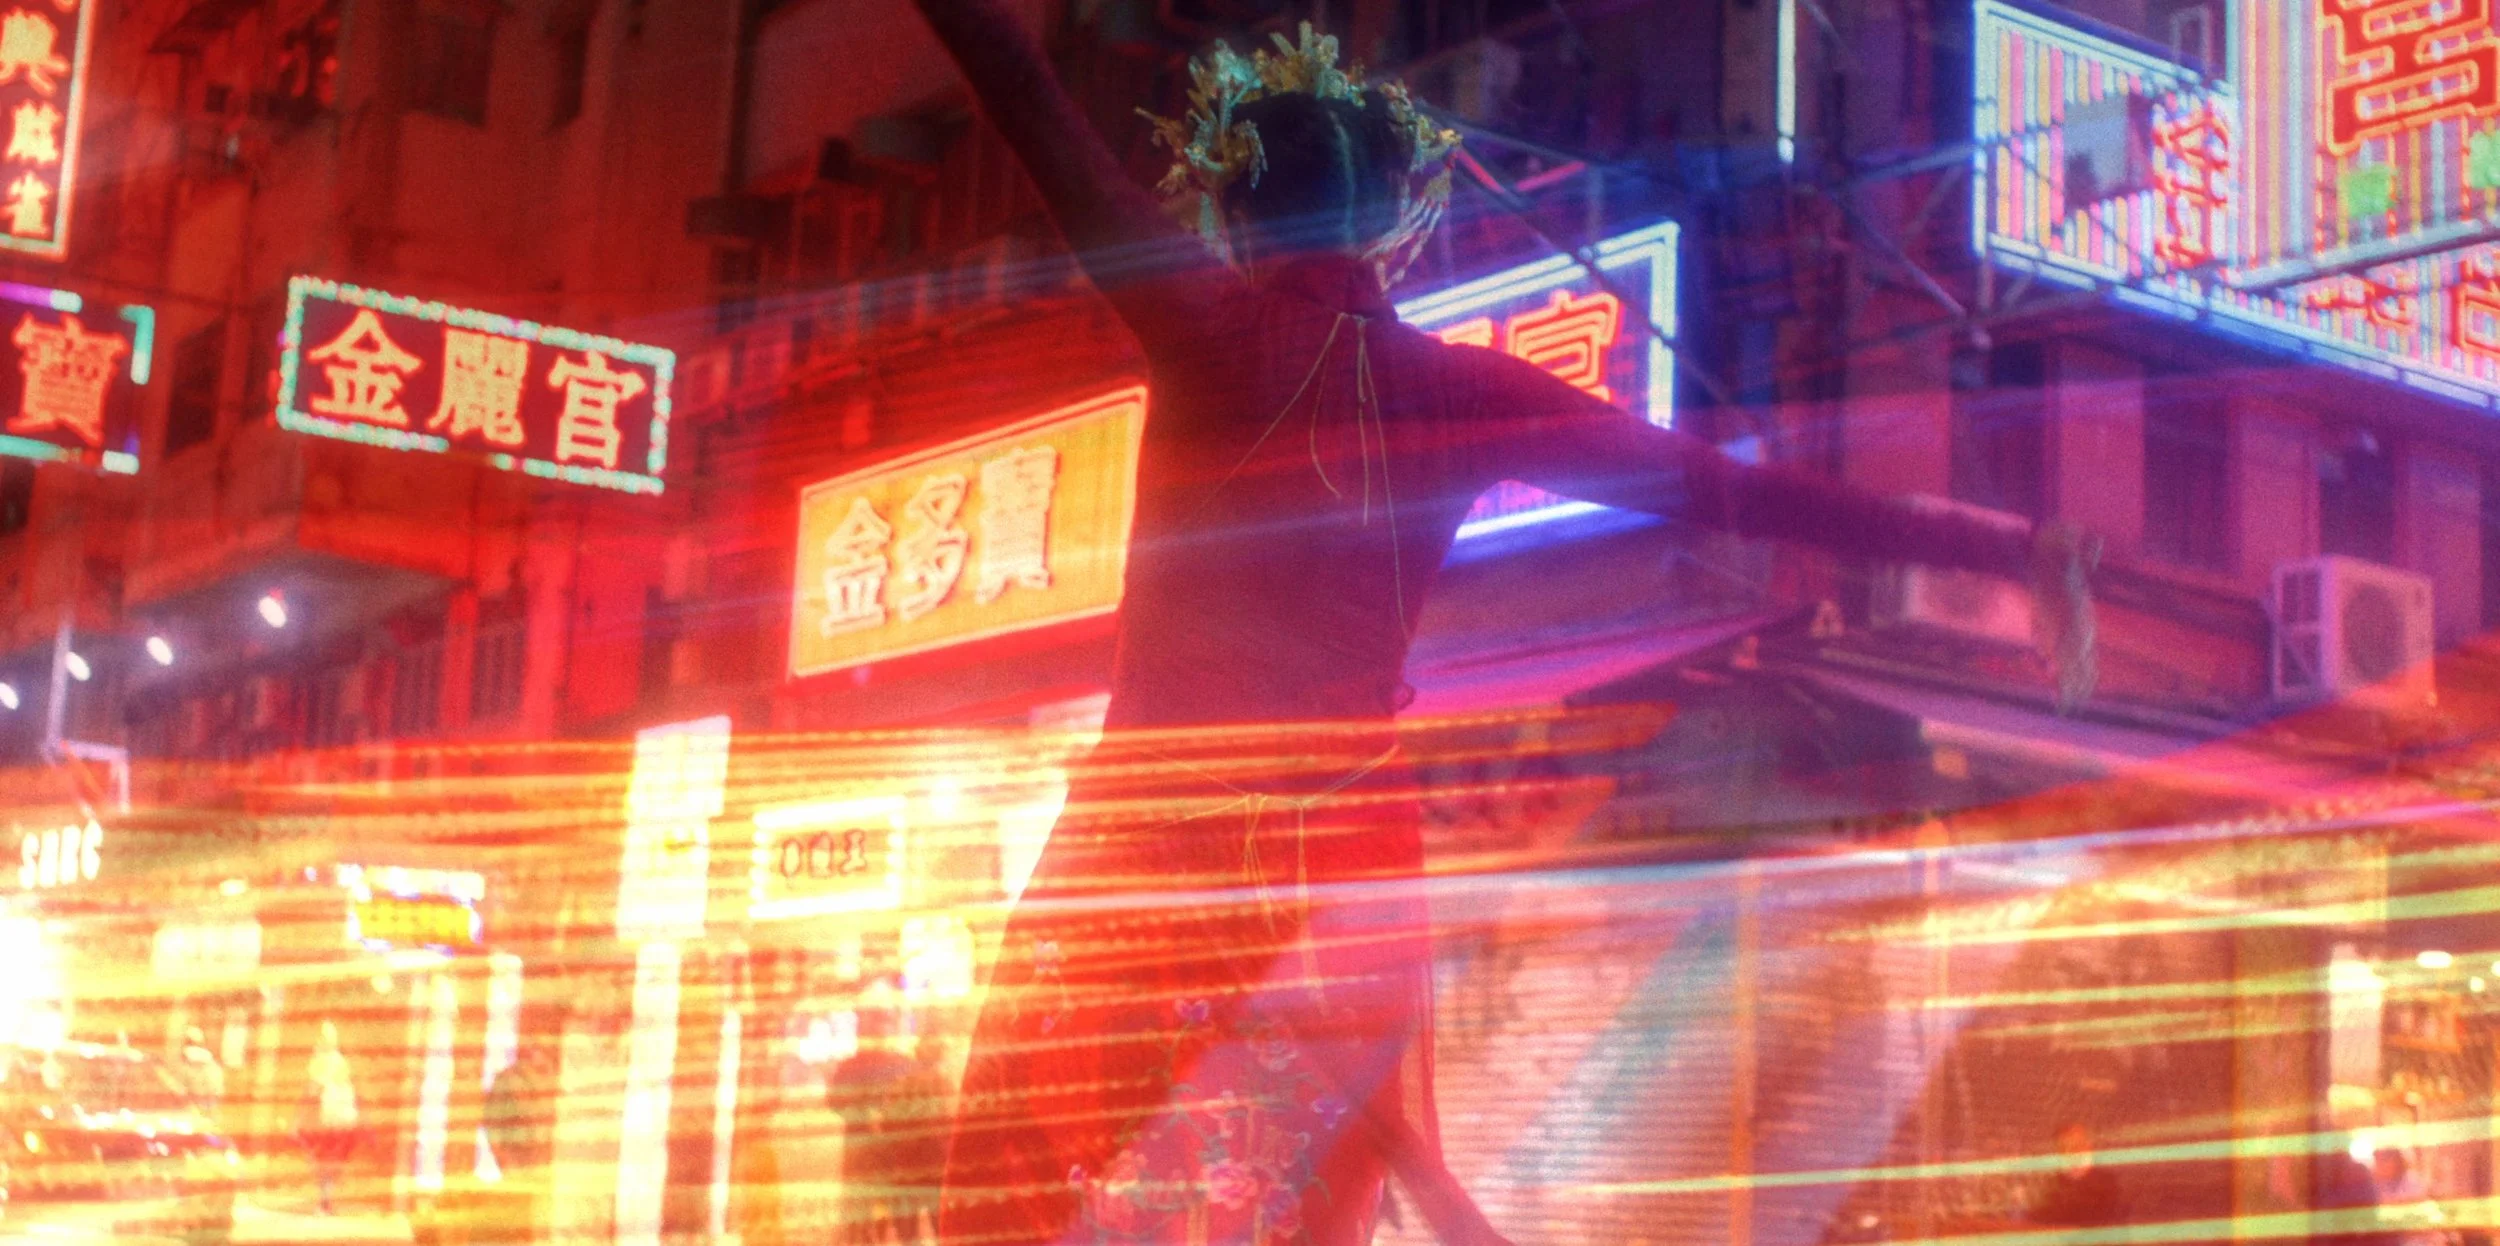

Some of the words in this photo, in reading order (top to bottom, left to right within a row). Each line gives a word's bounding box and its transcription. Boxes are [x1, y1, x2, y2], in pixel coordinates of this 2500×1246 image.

[7, 312, 131, 446] 寶
[819, 445, 1060, 640] 金多寶
